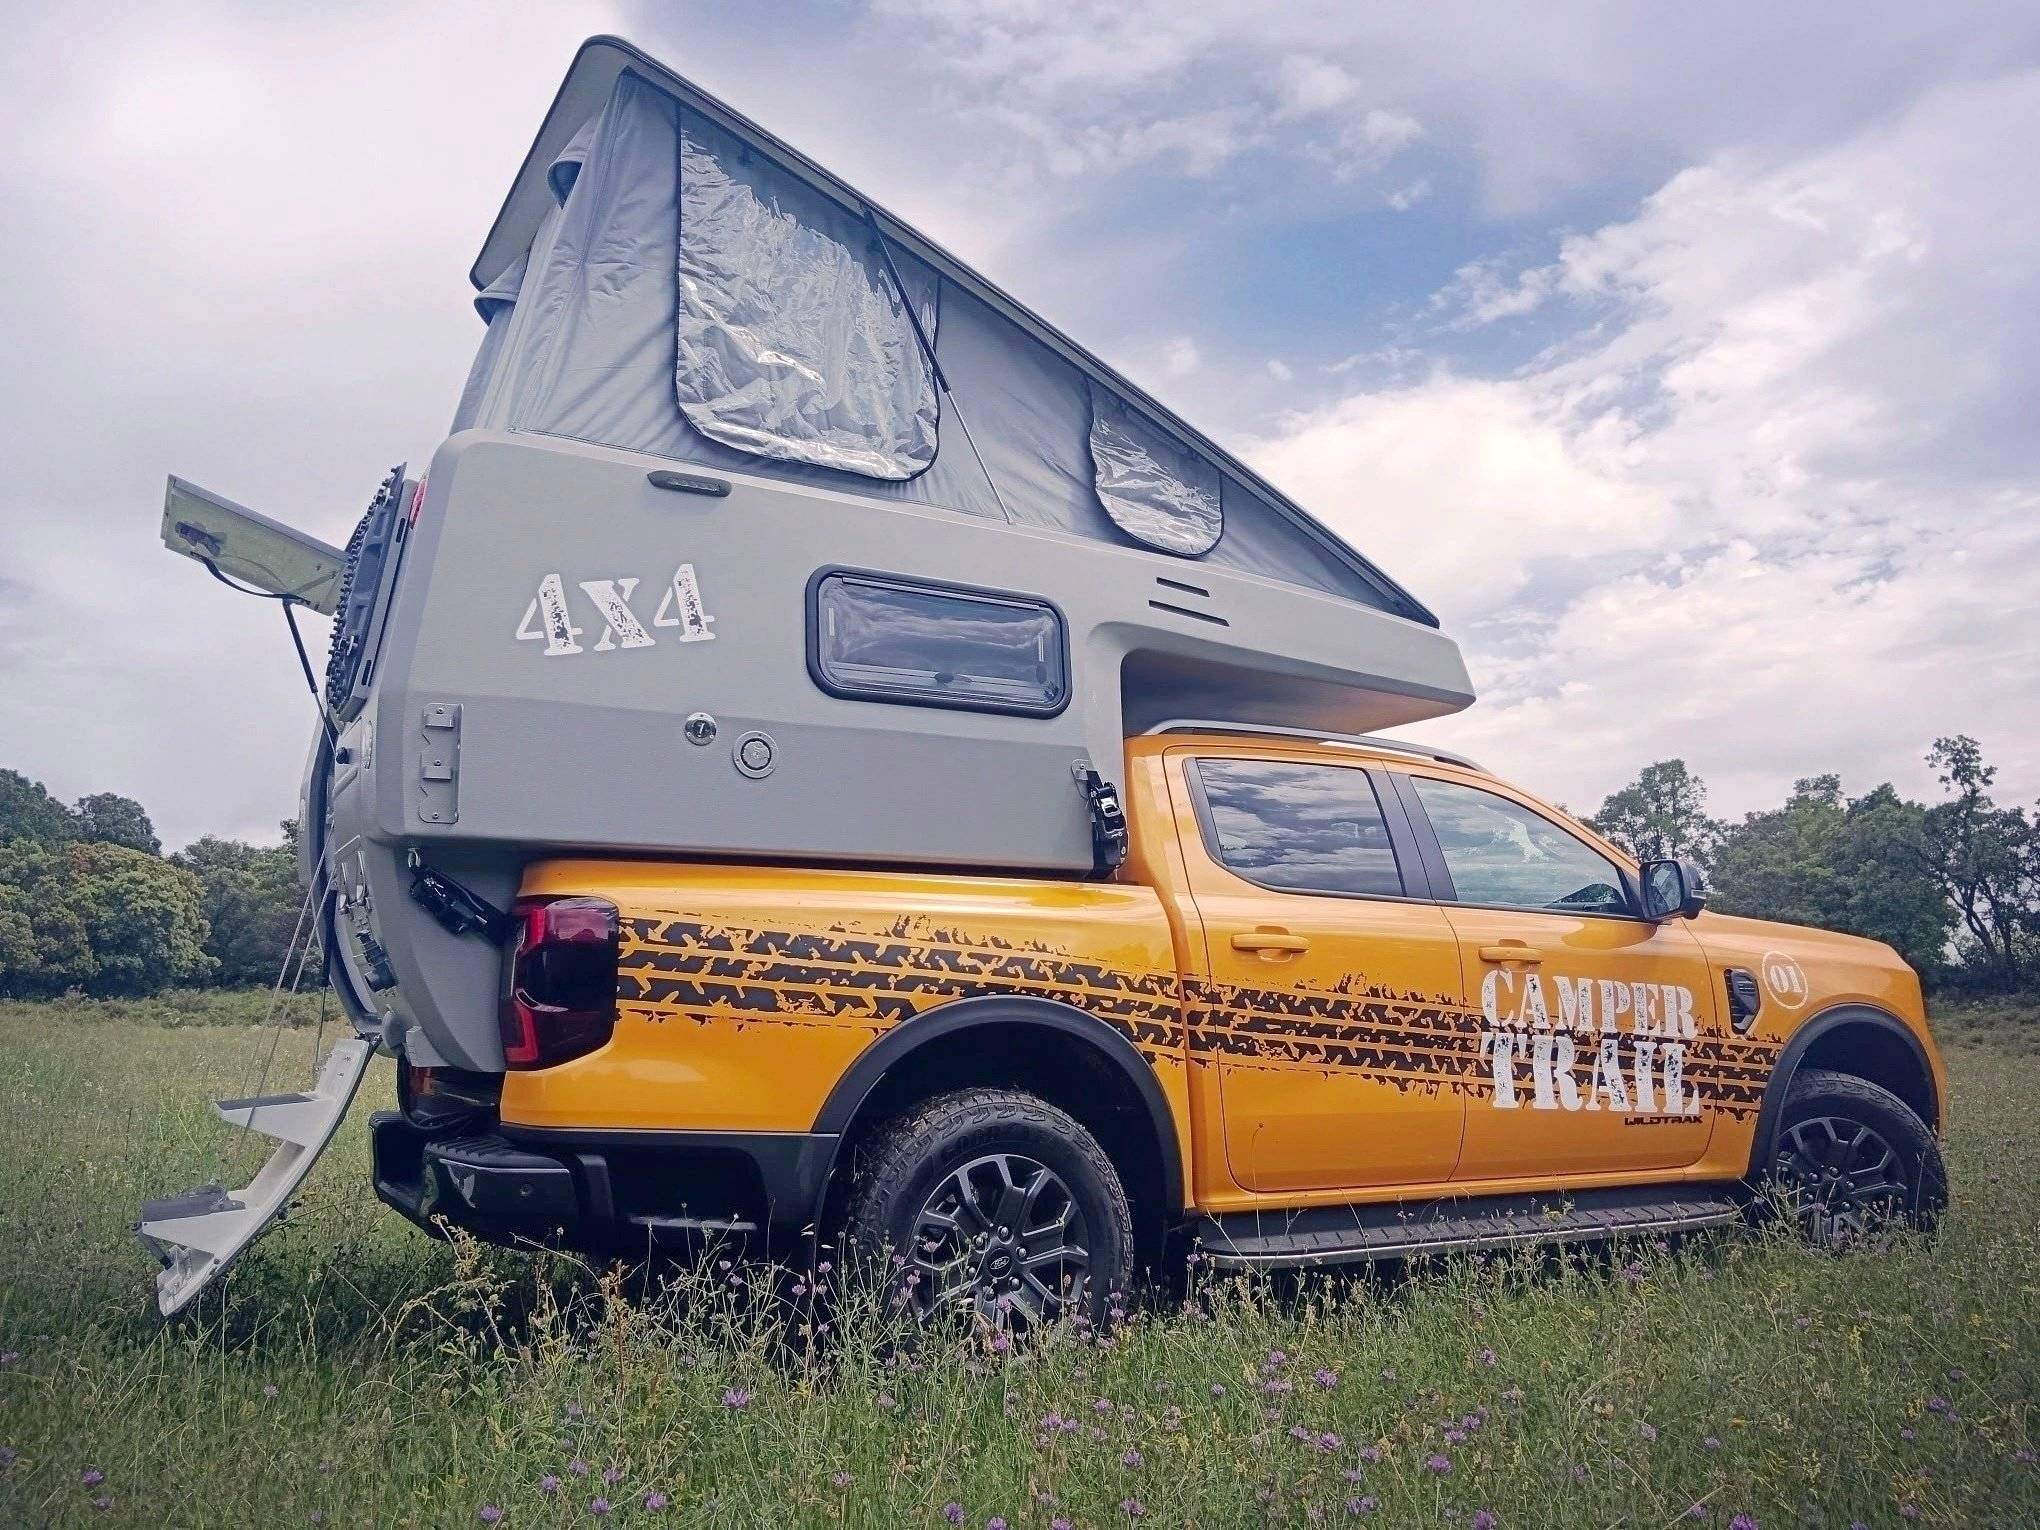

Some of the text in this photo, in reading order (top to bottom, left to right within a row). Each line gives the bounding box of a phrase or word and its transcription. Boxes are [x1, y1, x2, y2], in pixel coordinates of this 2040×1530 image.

[1481, 969, 1699, 1040] CAMPER
[1770, 965, 1803, 993] 01
[1480, 1032, 1700, 1115] TRAIL
